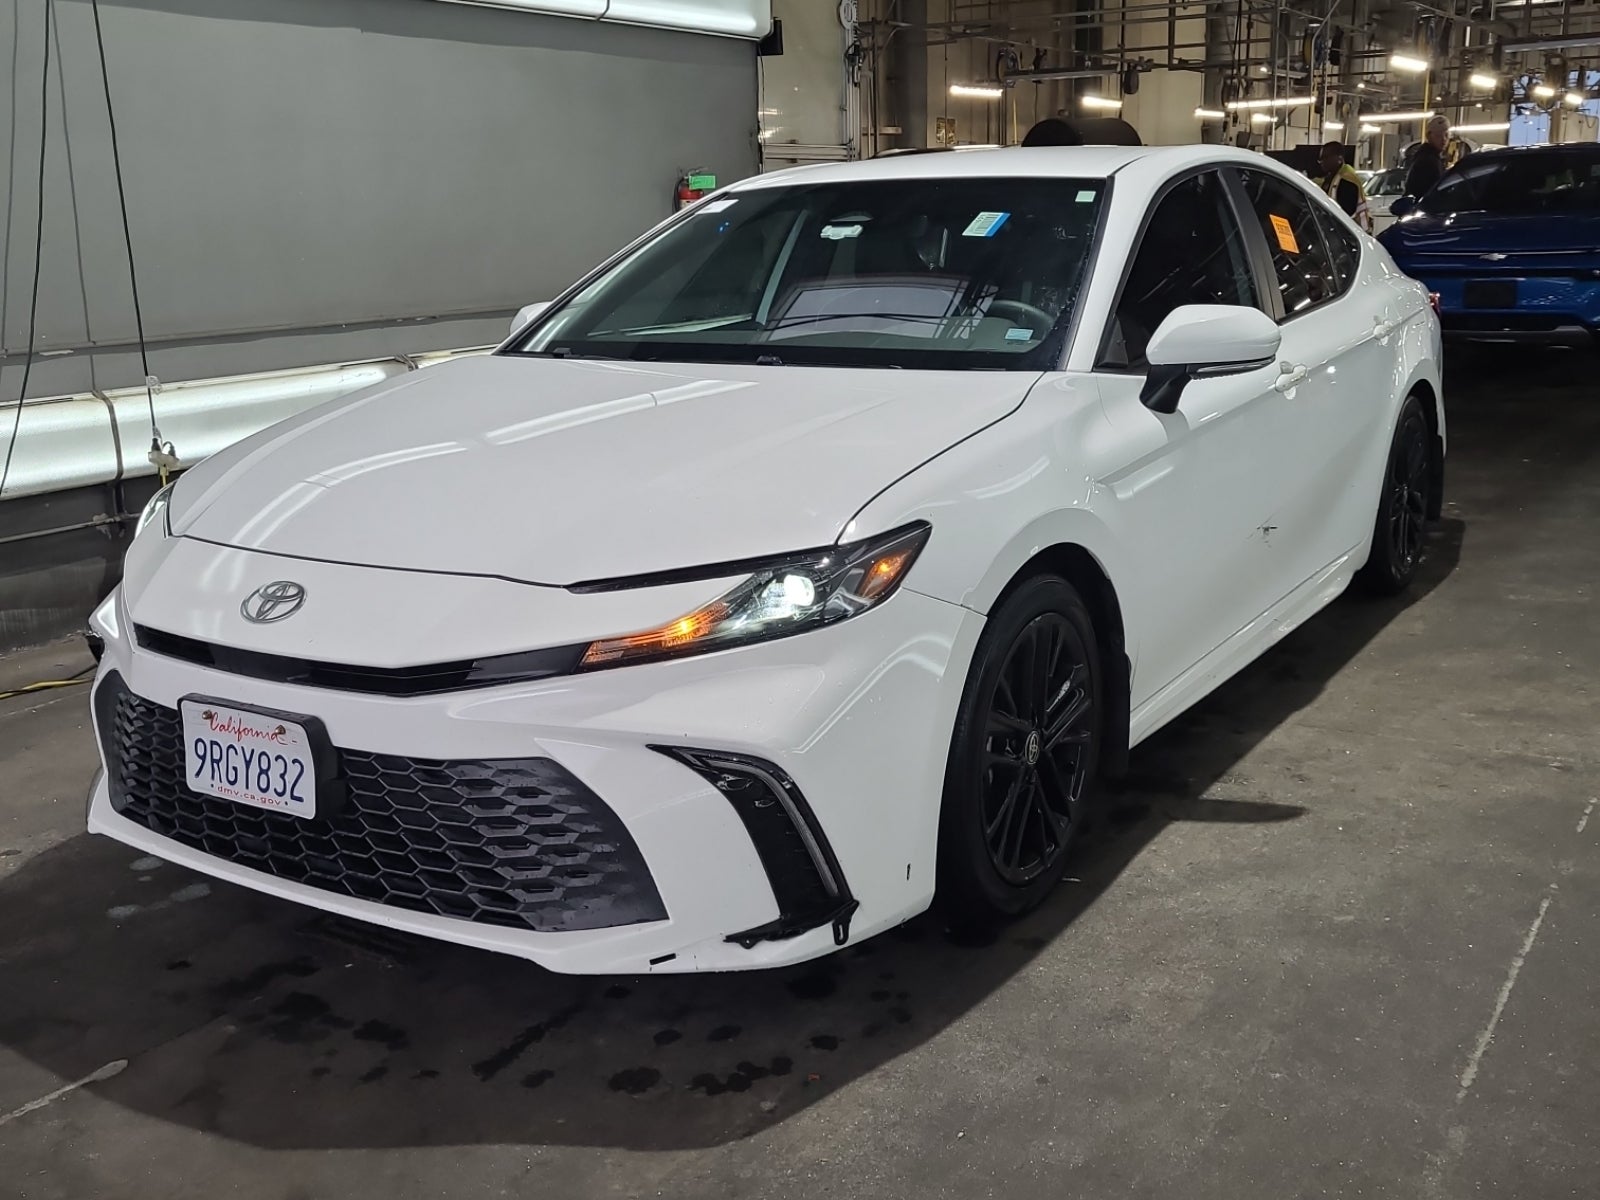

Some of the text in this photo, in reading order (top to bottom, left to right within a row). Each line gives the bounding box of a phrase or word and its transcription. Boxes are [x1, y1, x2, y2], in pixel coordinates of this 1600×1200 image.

[210, 711, 288, 745] California
[194, 737, 305, 803] 9RGY832
[217, 785, 282, 806] dmv.ca.gov
